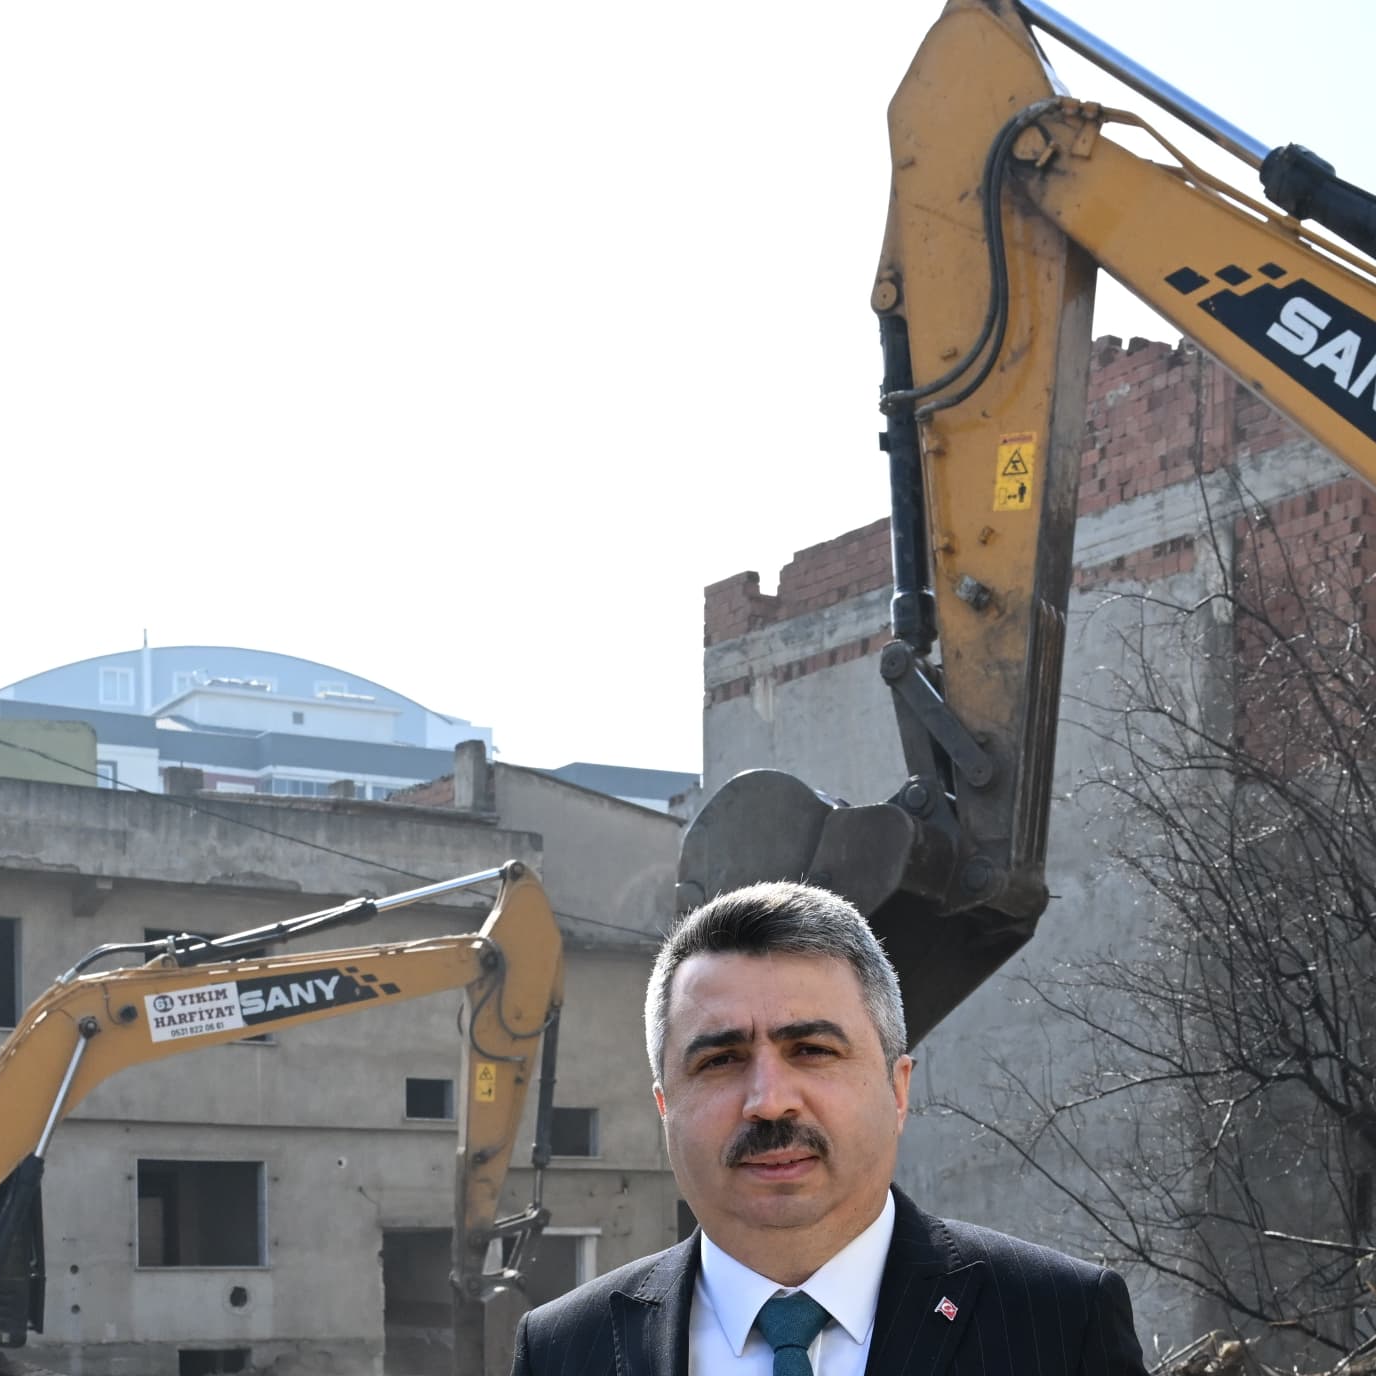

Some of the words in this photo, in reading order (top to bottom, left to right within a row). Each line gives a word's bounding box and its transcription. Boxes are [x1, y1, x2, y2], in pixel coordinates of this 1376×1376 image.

[177, 989, 228, 1006] YIKIM
[239, 975, 341, 1016] SANY
[154, 1005, 235, 1028] HARFİYAT
